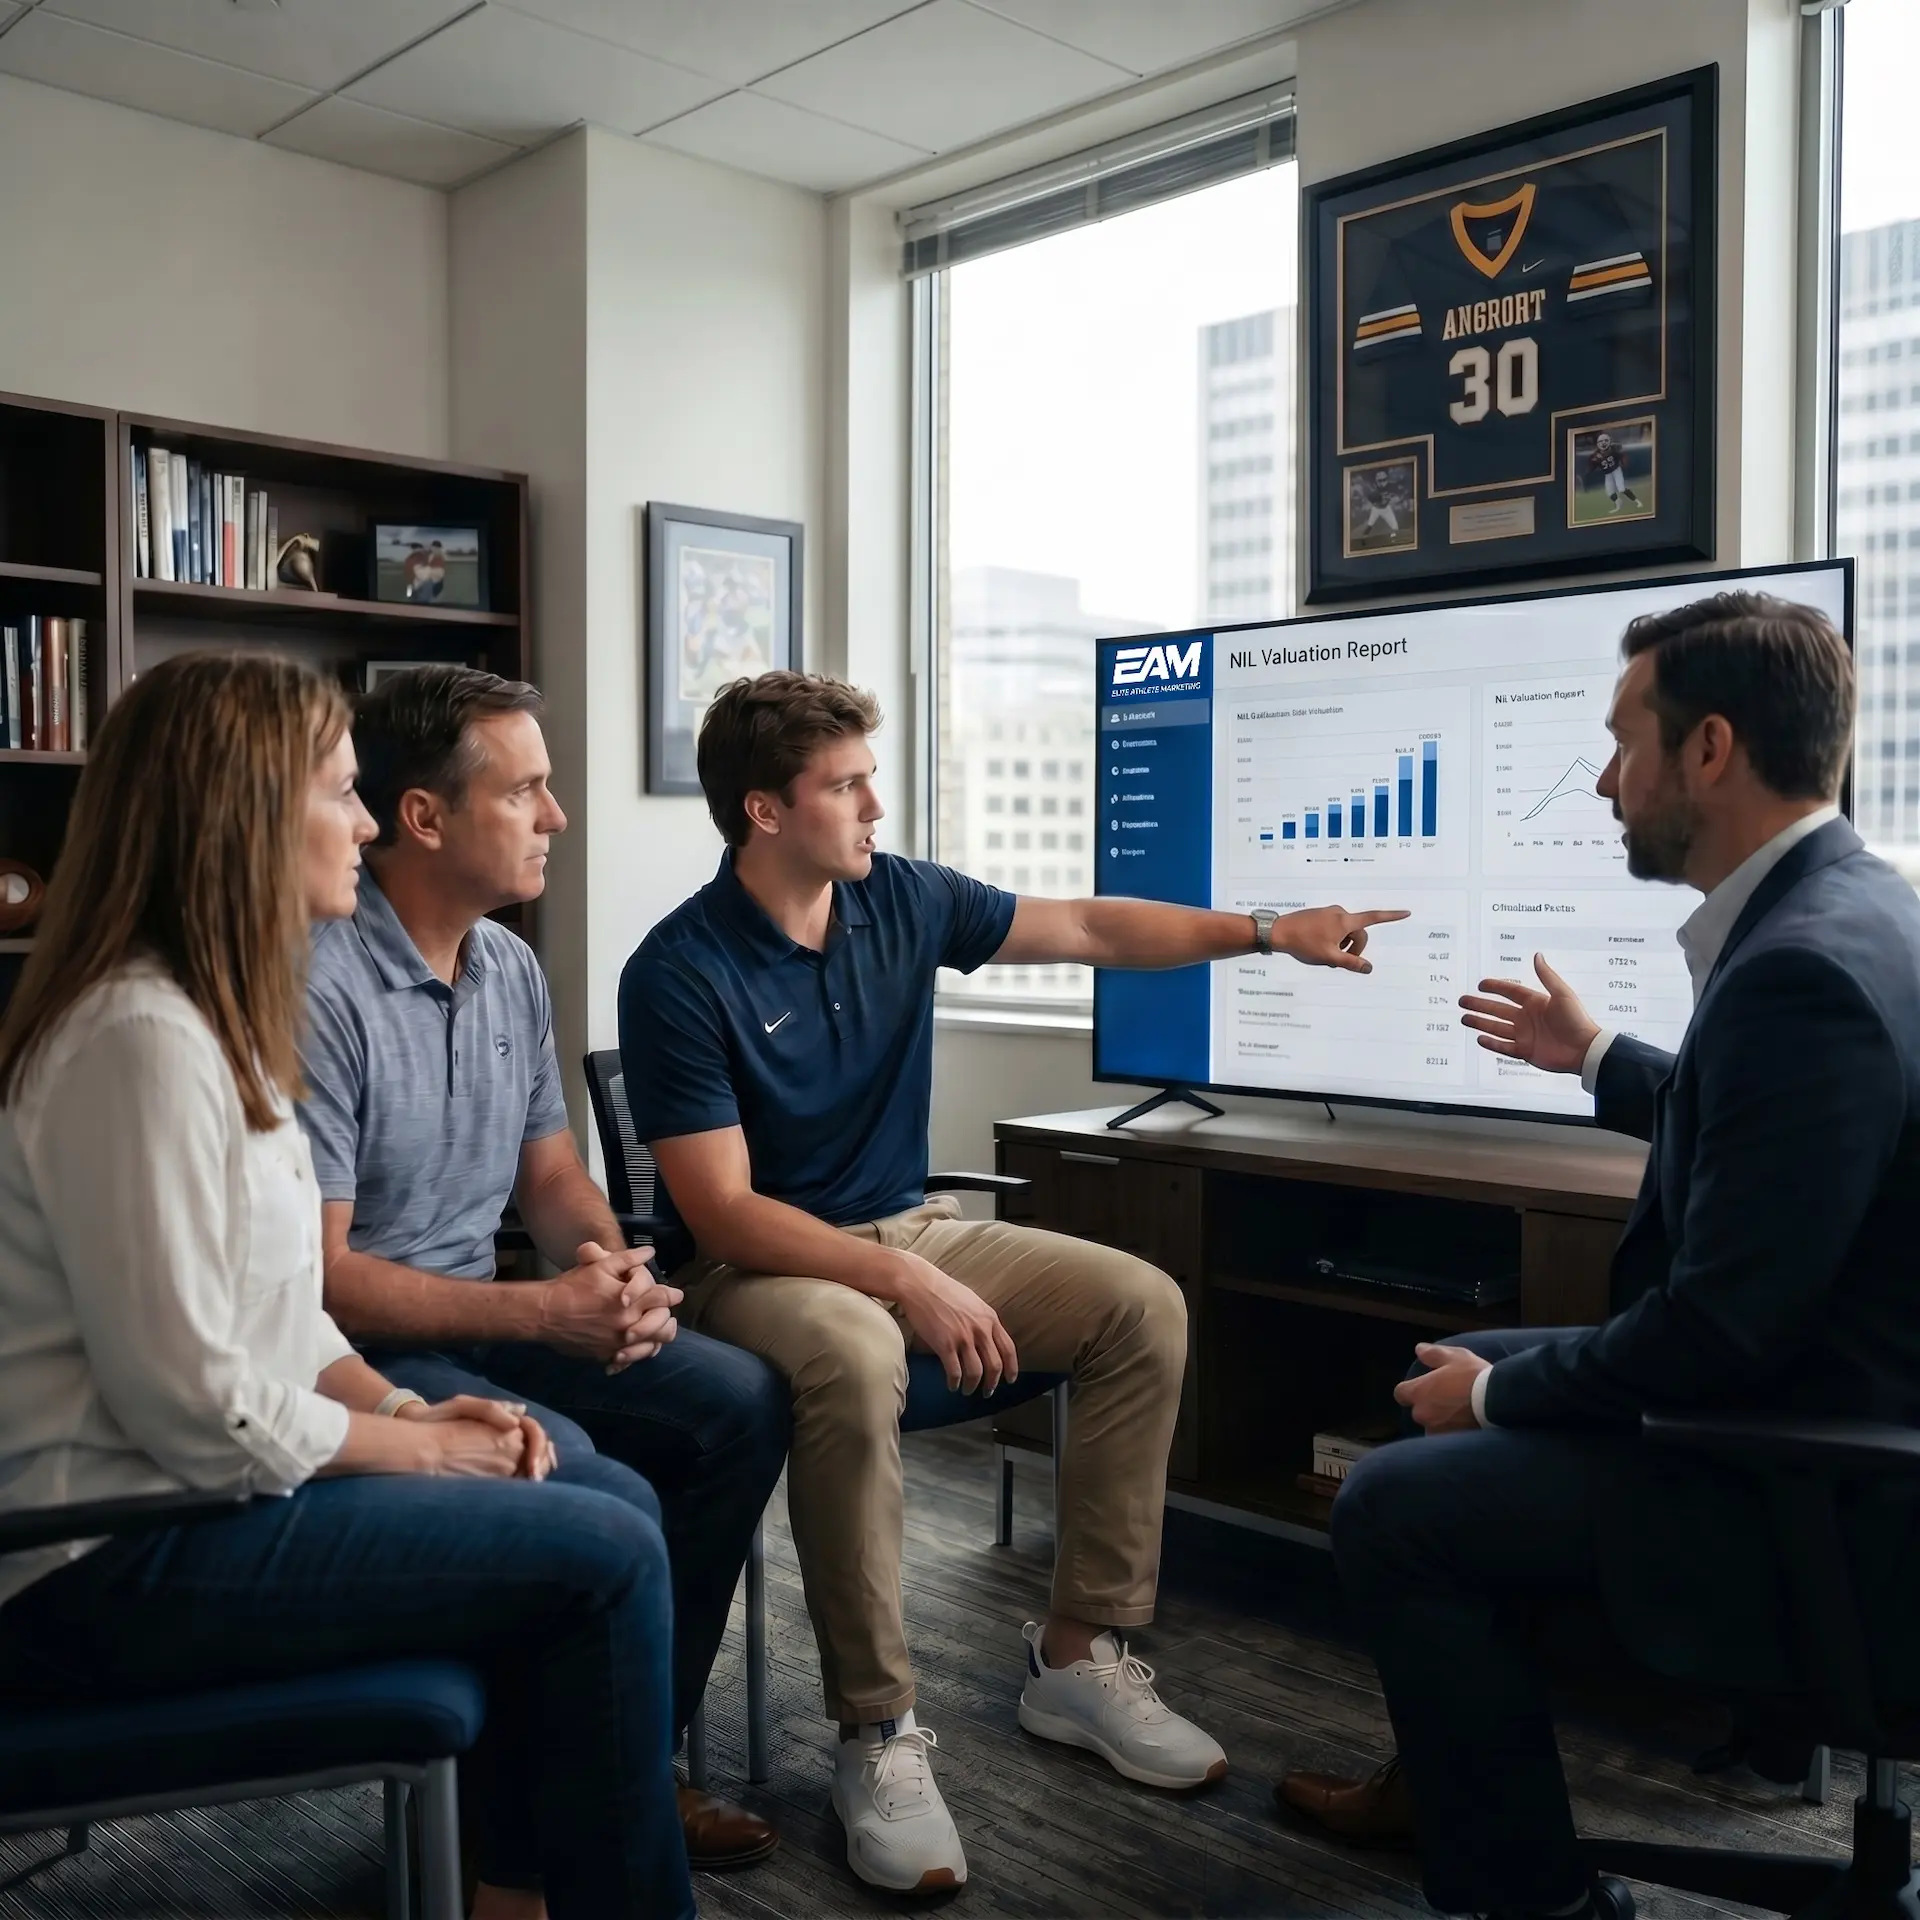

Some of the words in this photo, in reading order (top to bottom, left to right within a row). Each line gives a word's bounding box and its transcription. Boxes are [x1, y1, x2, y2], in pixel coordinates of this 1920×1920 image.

[1448, 336, 1539, 426] 30
[1112, 641, 1203, 685] EAM
[1230, 651, 1257, 669] NIL
[1261, 644, 1341, 666] Valuation
[1347, 637, 1408, 662] Report
[1111, 688, 1129, 698] ELITE
[1130, 685, 1160, 696] ATHLETE
[1160, 681, 1201, 693] MARKETING
[1510, 692, 1552, 703] Valuation
